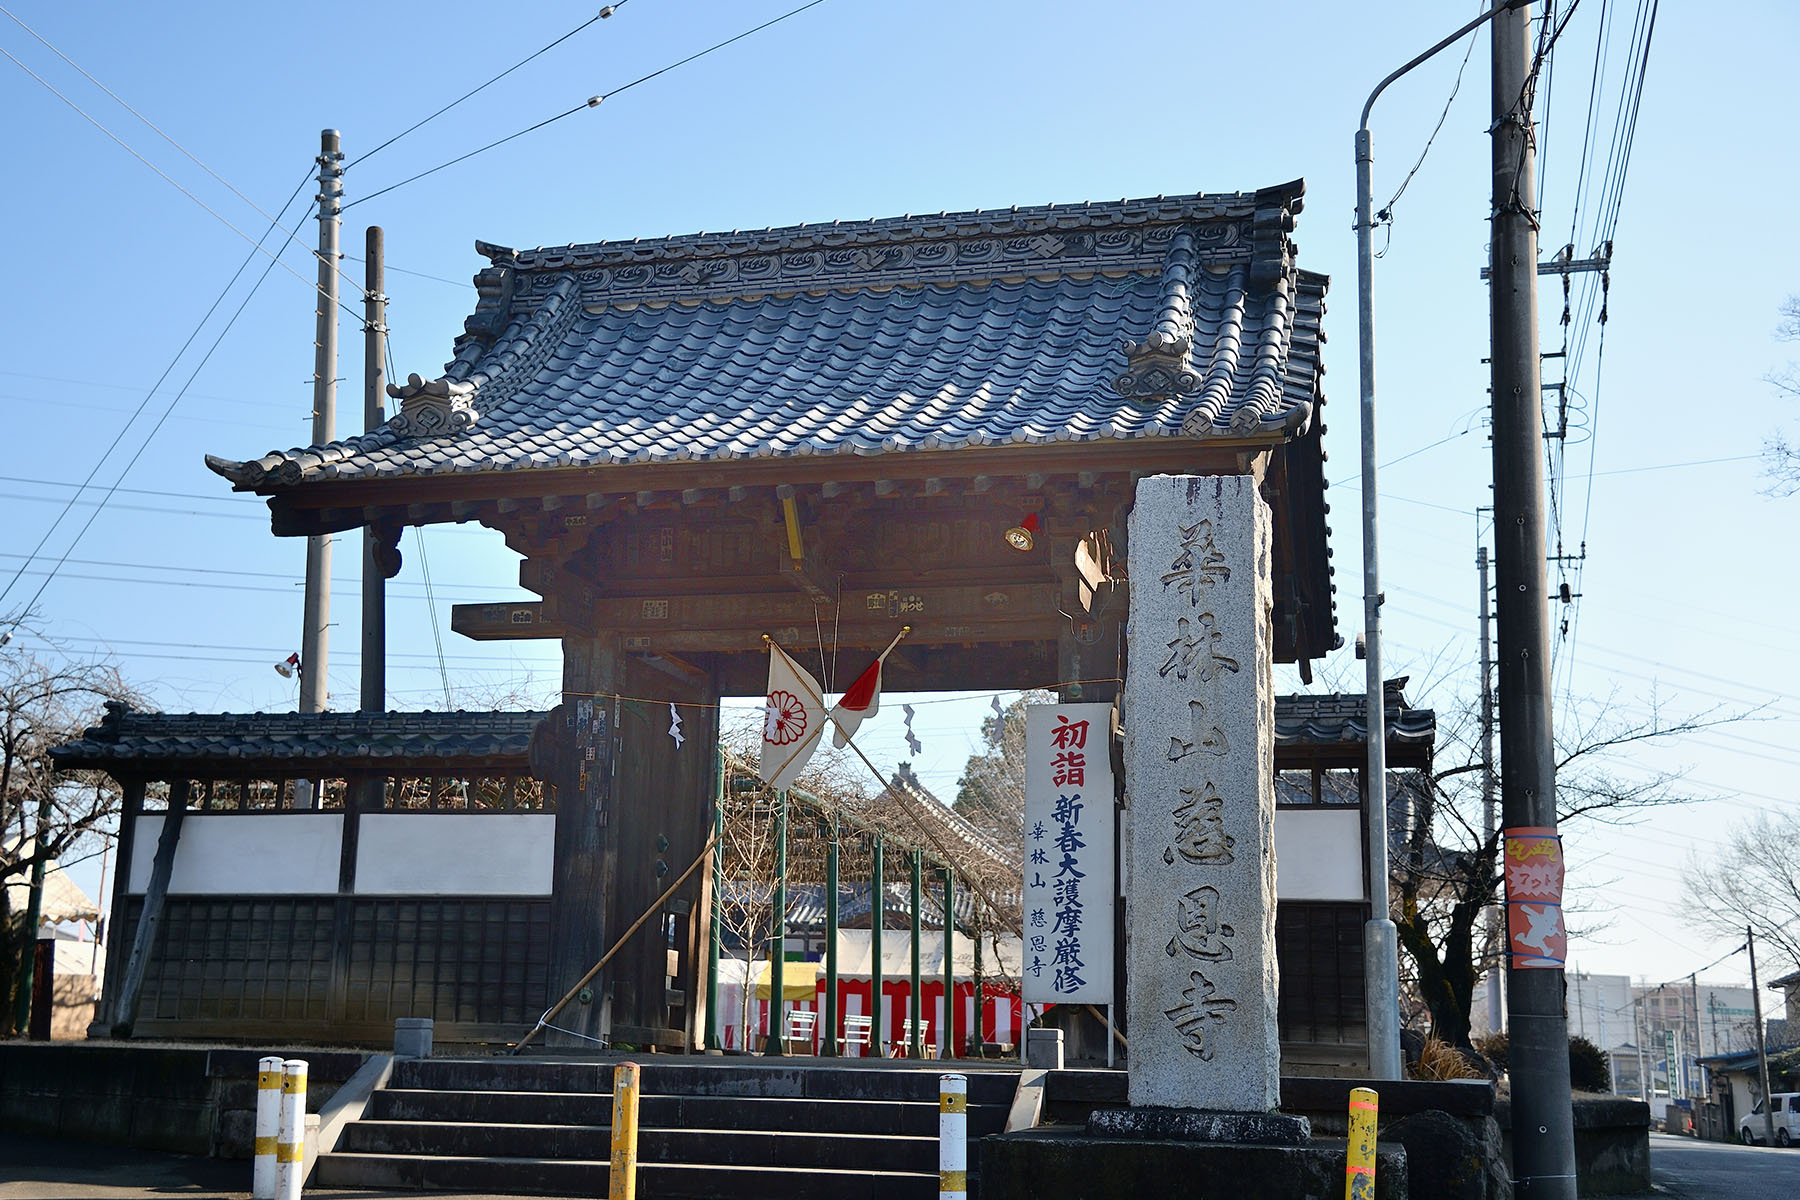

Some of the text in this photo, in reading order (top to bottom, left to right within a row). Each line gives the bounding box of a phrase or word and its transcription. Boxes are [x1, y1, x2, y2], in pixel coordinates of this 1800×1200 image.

[1025, 820, 1050, 978] 華林山 慈恩寺
[1050, 714, 1090, 994] 初詣 新春大護摩厳修
